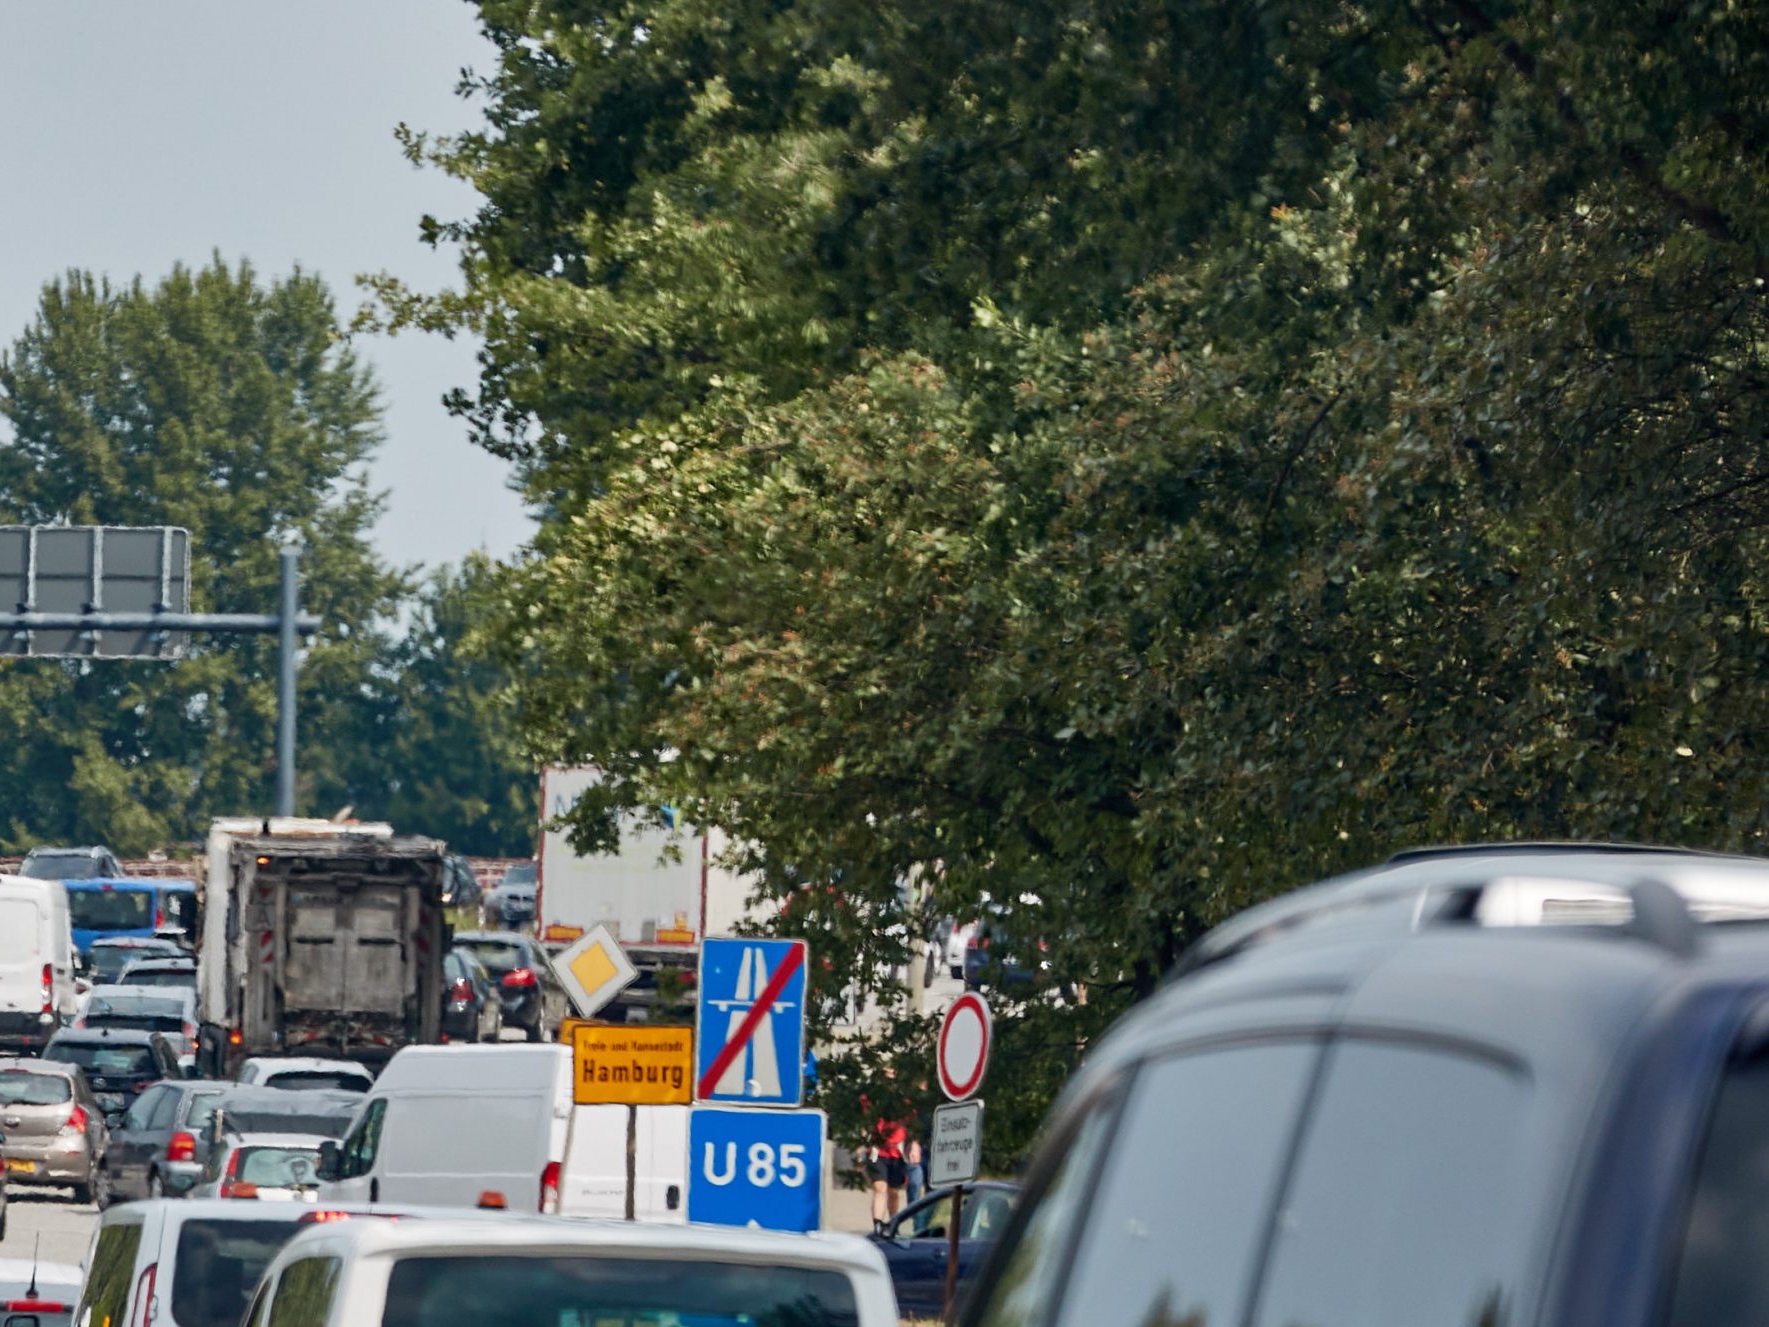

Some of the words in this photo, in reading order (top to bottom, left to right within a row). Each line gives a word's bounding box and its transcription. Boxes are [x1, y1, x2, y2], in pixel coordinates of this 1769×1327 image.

[583, 1040, 606, 1051] Freie
[612, 1040, 627, 1051] und
[631, 1040, 683, 1052] Hansestadt
[582, 1059, 683, 1089] Hamburg
[703, 1141, 737, 1187] U
[746, 1141, 807, 1188] 85
